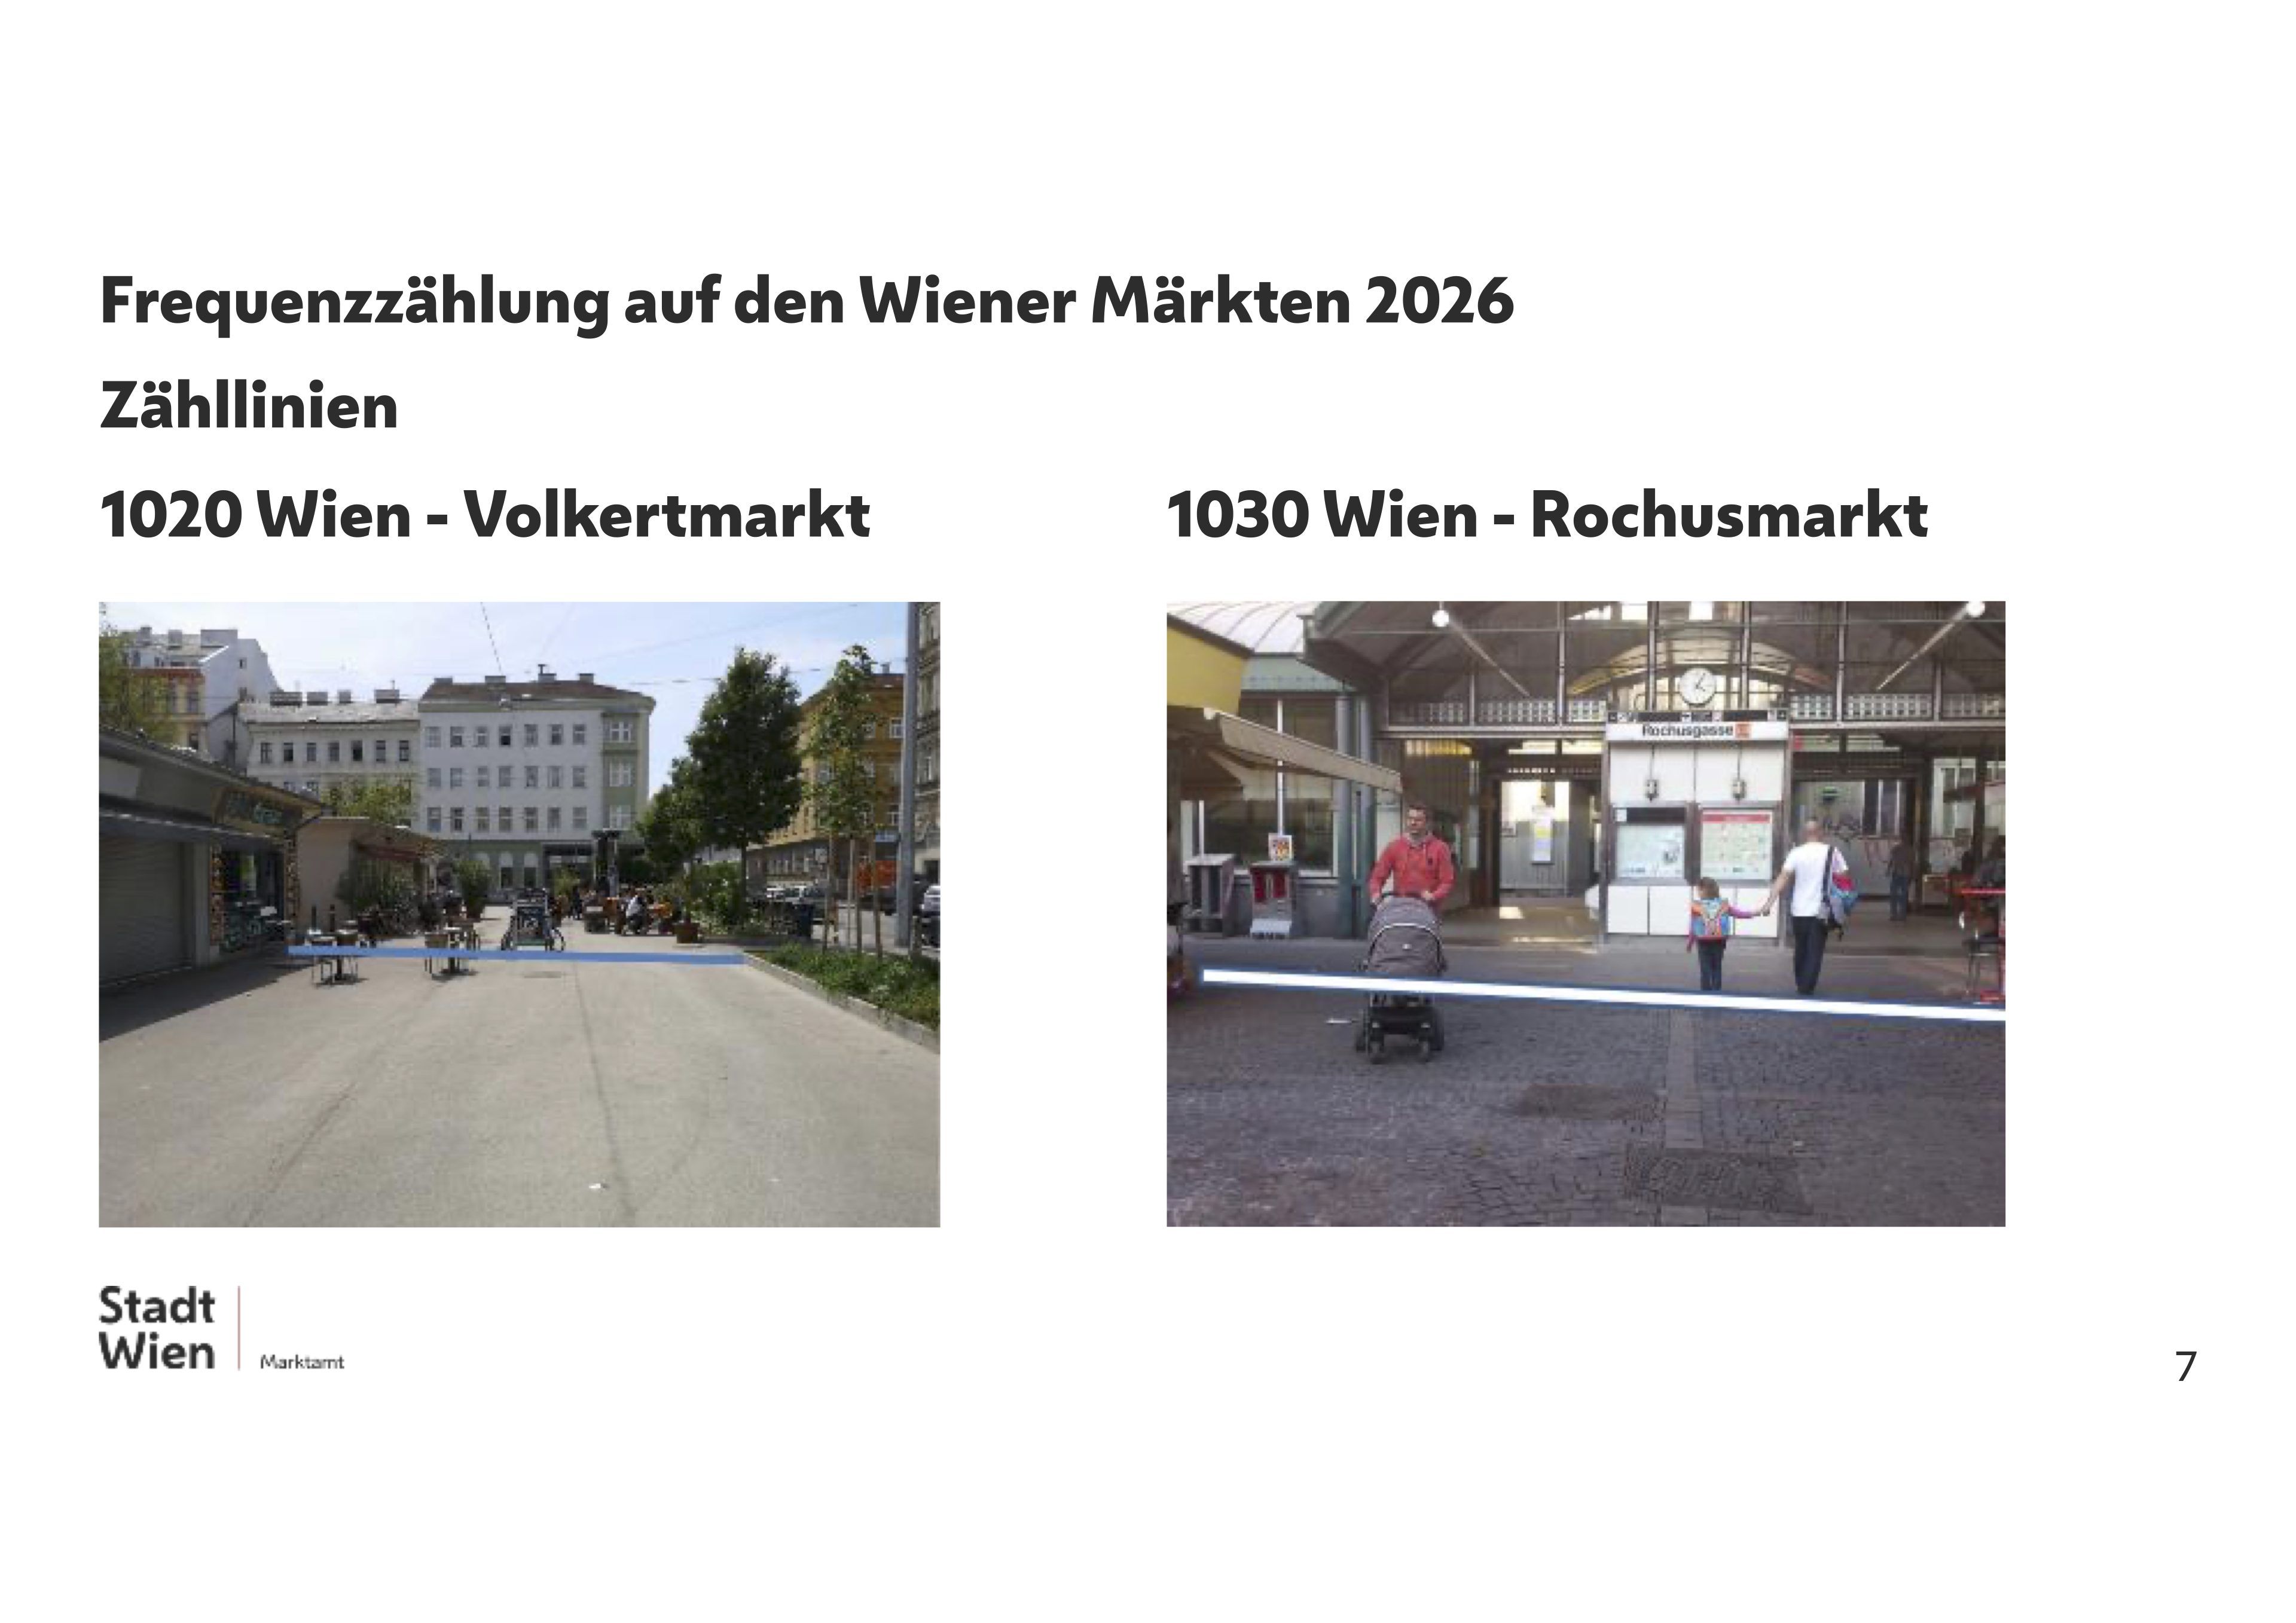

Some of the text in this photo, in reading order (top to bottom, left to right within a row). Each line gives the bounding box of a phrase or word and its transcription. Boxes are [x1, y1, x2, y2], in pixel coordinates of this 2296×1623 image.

[103, 274, 1513, 338] Frequenzzählung auf den Wiener Märkten 2026
[100, 379, 396, 428] Zähllinien
[102, 488, 870, 537] 1020 Wien - Volkertmarkt
[1168, 488, 1928, 537] 1030 Wien - Rochusmarkt
[1642, 725, 1733, 738] Rochusgasse
[99, 1286, 215, 1324] Stadt
[99, 1331, 215, 1369] Wien
[261, 1355, 344, 1369] Marktamt
[2176, 1352, 2197, 1381] 7
